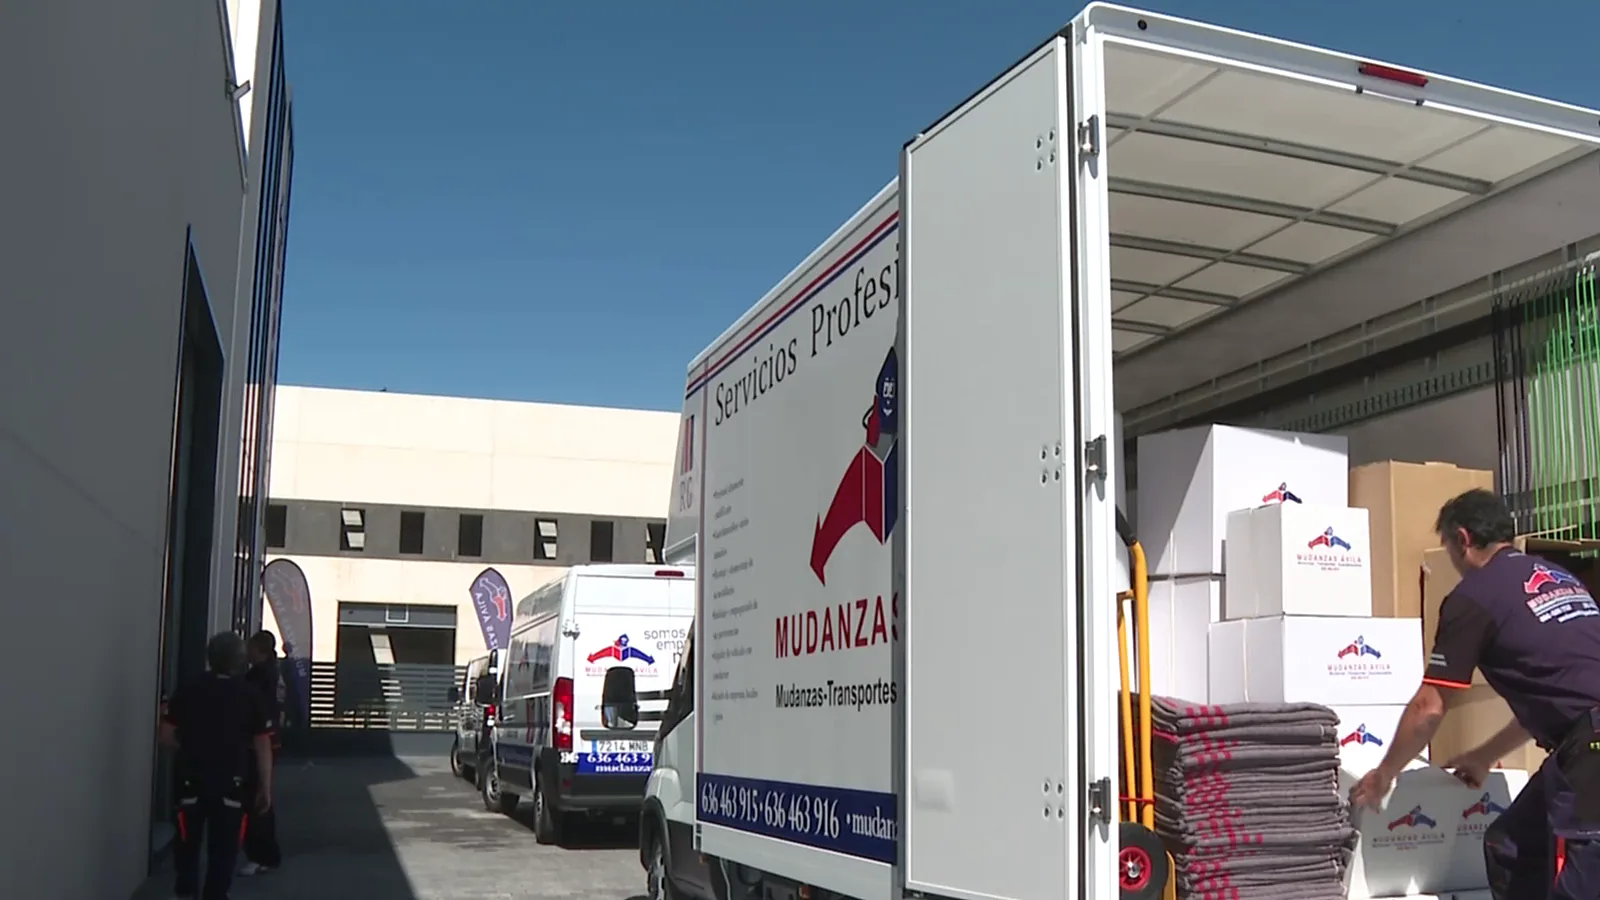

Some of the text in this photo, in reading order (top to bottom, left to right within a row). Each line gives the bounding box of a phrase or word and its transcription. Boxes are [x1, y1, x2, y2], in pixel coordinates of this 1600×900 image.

[715, 338, 798, 426] Servicios
[679, 476, 693, 512] RG
[644, 628, 686, 640] somos
[587, 752, 612, 764] 636
[614, 752, 639, 764] 463
[599, 741, 626, 752] 7214
[701, 782, 719, 815] 636
[720, 785, 738, 819] 463
[739, 787, 758, 823] 915
[764, 791, 787, 828] 636
[788, 794, 811, 833] 463
[813, 797, 840, 839] 916
